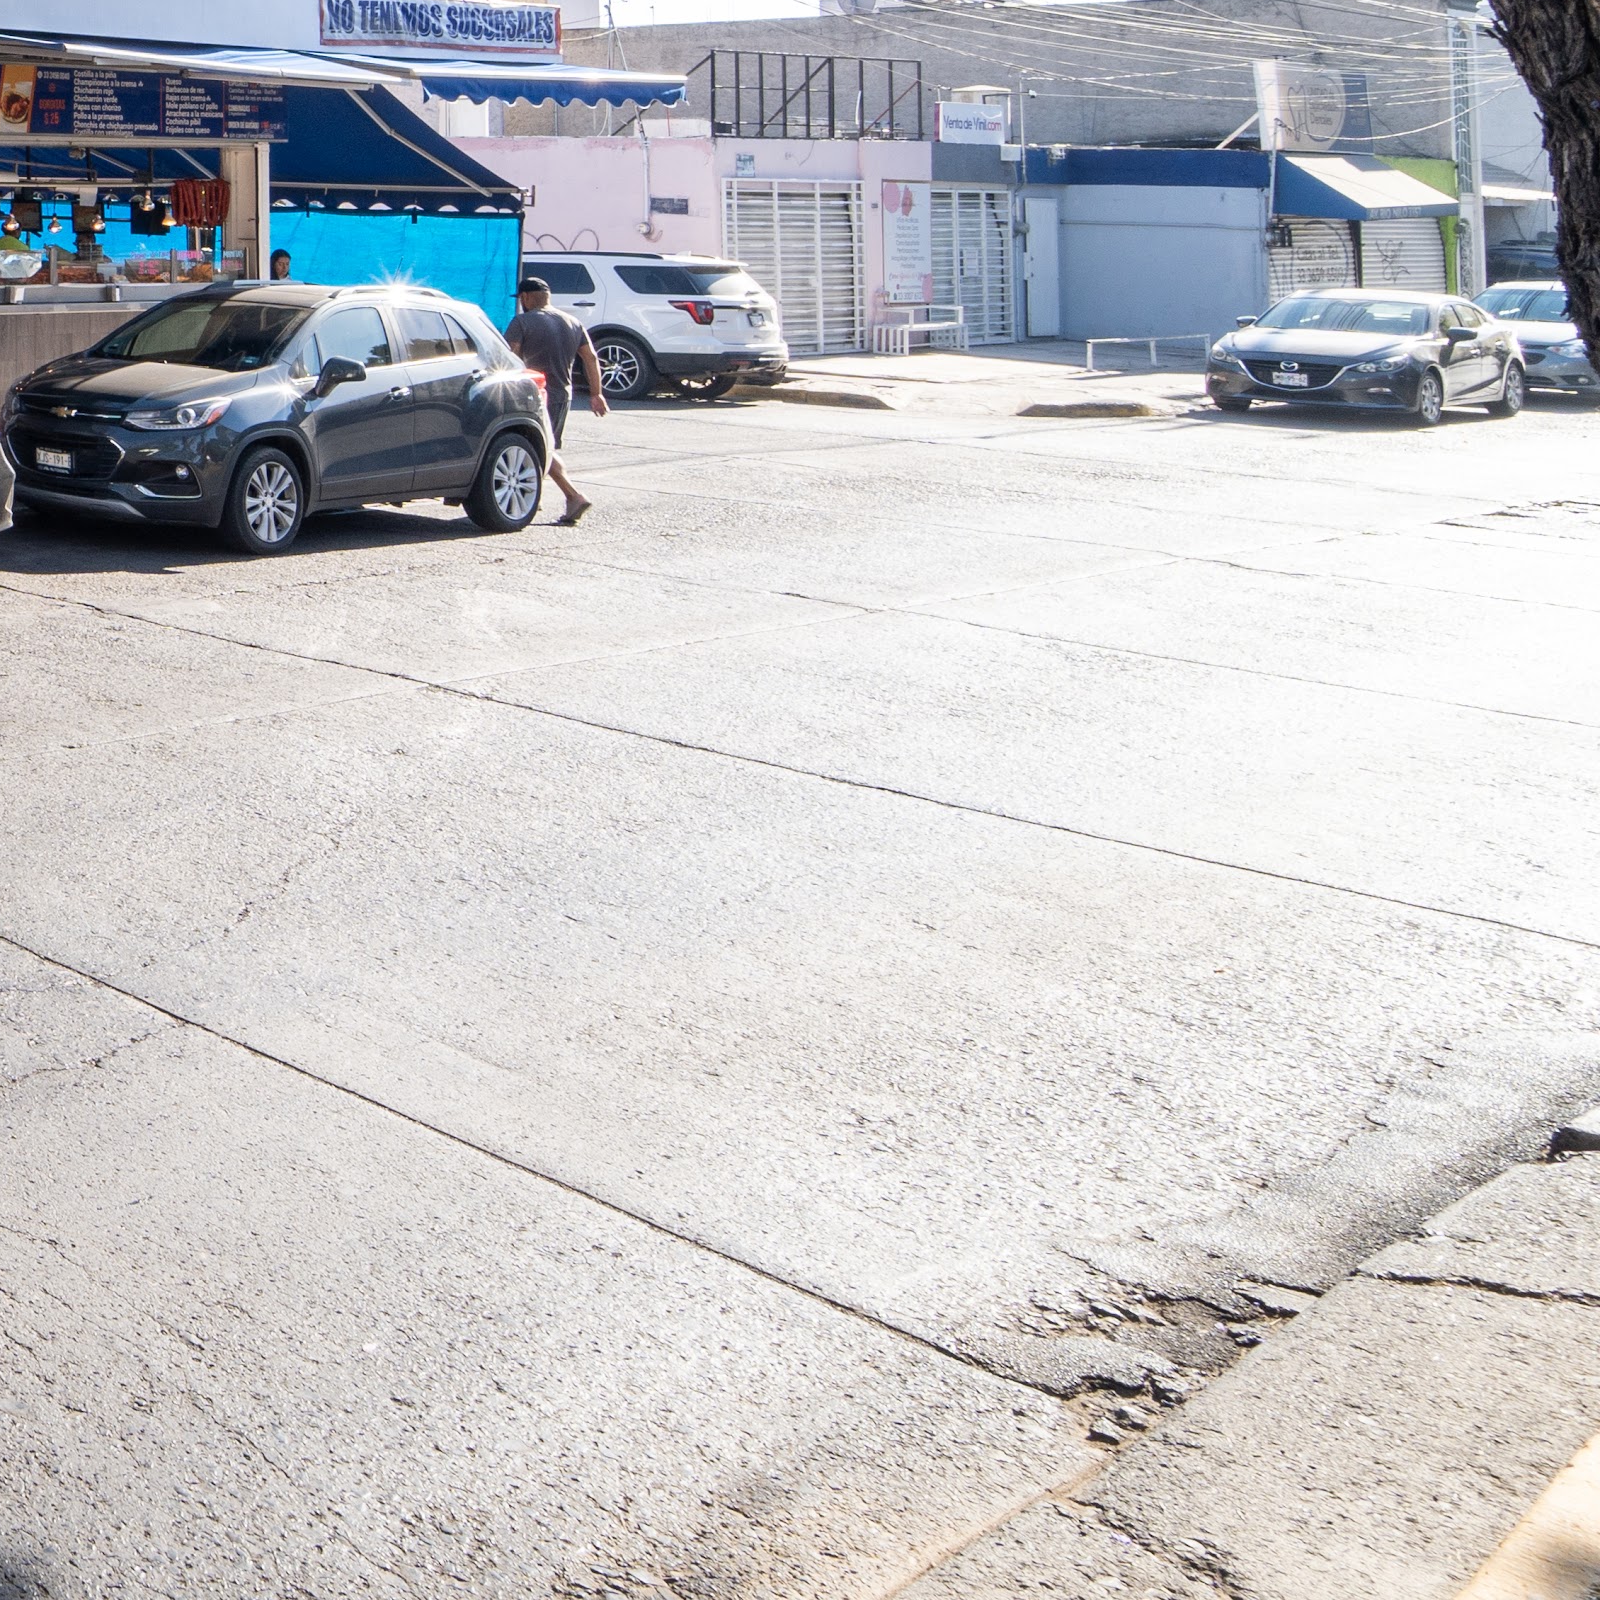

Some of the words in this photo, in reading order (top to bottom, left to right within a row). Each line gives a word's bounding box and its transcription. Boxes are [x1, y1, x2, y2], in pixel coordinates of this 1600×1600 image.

[327, 0, 355, 33] NO
[358, 0, 444, 37] TENEMOS
[446, 3, 554, 43] SUCURSALES
[943, 115, 963, 130] Venta
[964, 117, 973, 130] de
[973, 116, 1002, 131] Vinil.com
